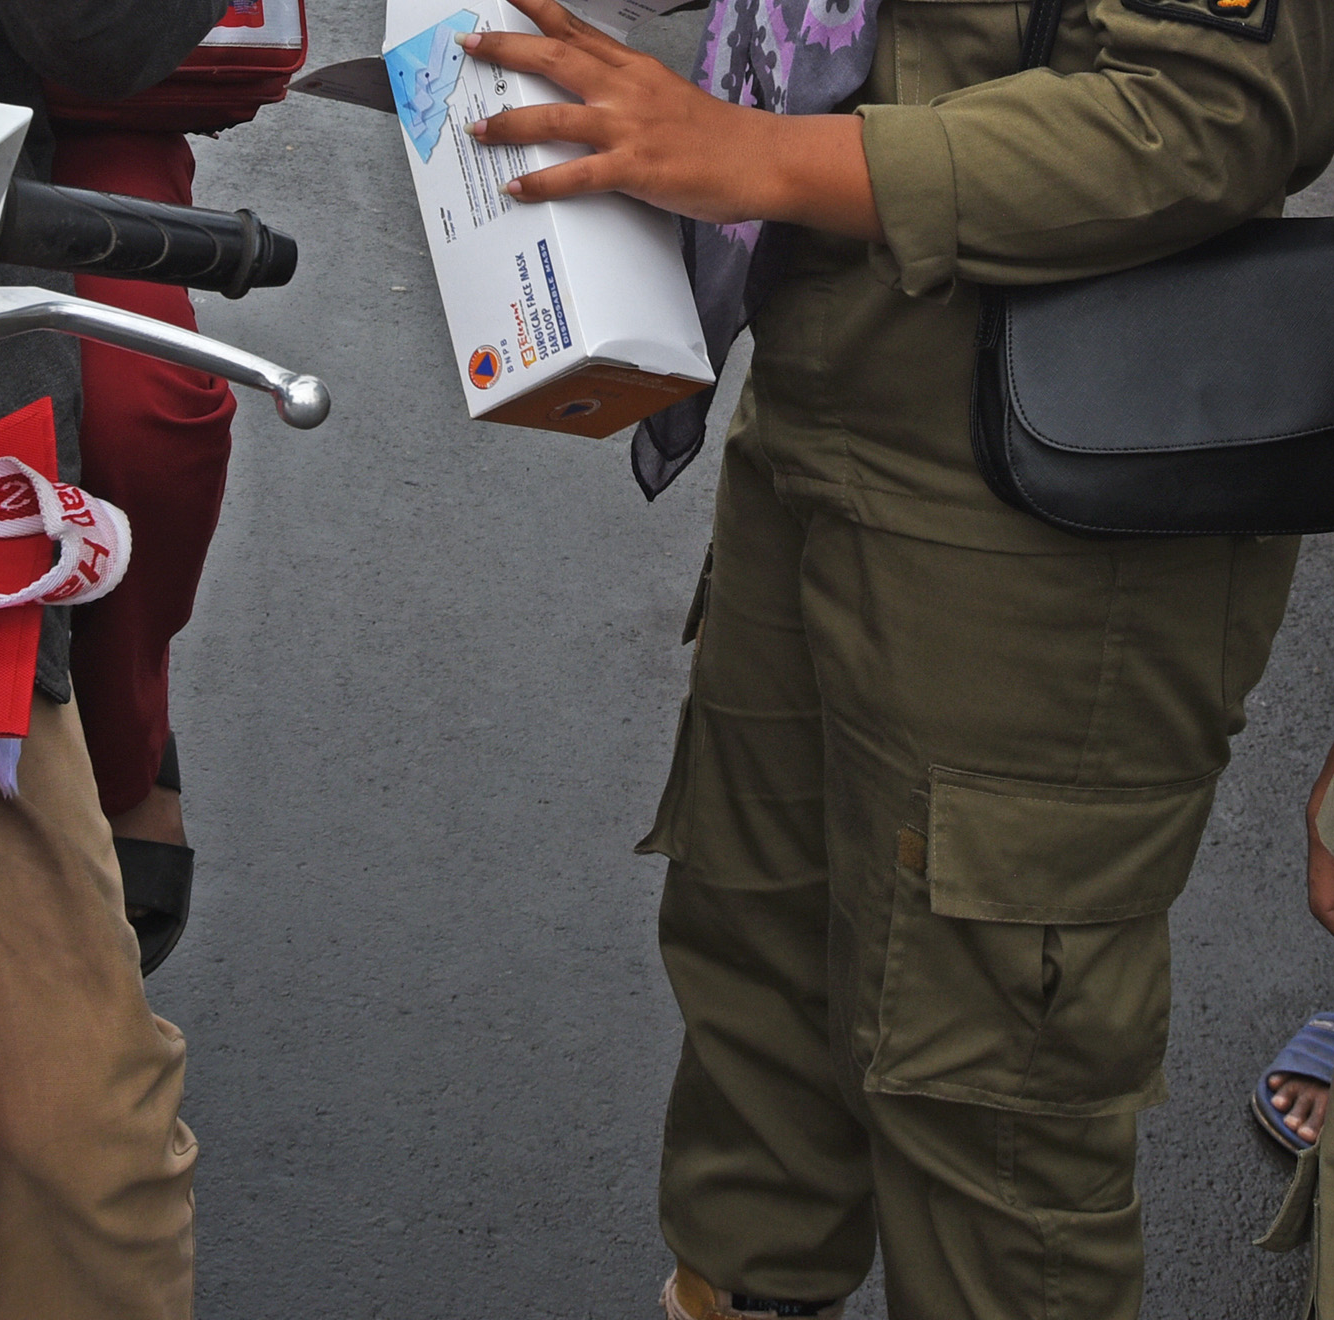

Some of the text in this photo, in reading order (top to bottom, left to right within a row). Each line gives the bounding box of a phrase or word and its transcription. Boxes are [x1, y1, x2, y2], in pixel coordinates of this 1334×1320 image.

[515, 251, 549, 361] SURGICAL FACE MASK
[539, 242, 570, 344] DISPOSABLE MASK
[500, 338, 514, 373] BNPB
[541, 307, 561, 355] EARLOOP
